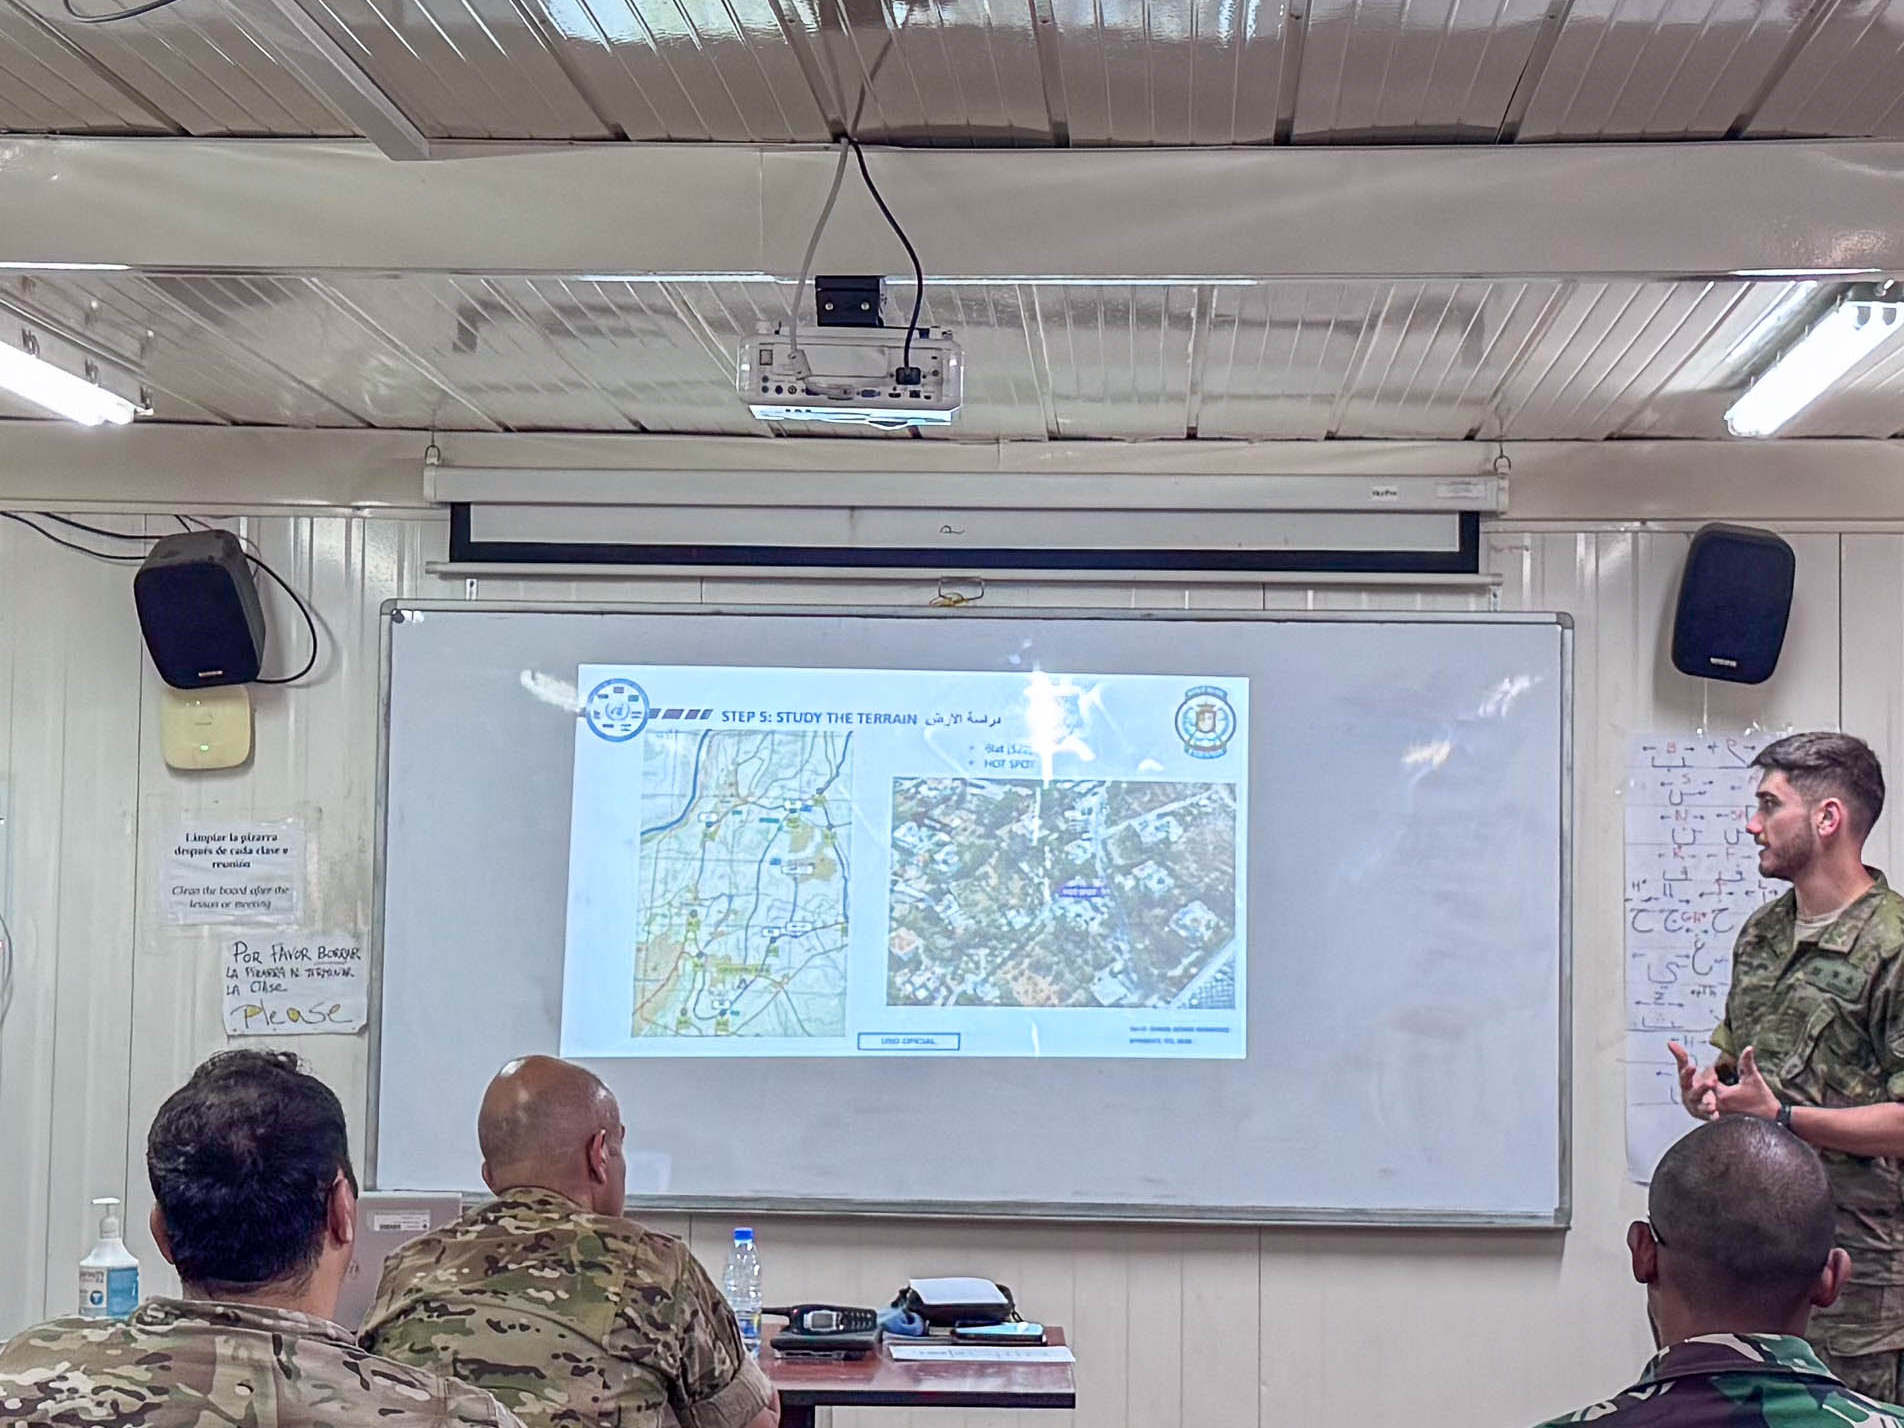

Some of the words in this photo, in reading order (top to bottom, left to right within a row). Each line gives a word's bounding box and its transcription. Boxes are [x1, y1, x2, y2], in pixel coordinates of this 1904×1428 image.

[721, 710, 755, 723] STEP
[759, 711, 773, 723] 5:
[776, 711, 822, 724] STUDY
[826, 712, 853, 724] THE
[857, 712, 918, 725] TERRAIN
[185, 832, 227, 844] Limpiar
[229, 832, 239, 843] la
[241, 832, 278, 844] pizarra
[215, 846, 228, 856] de
[230, 845, 254, 855] cada
[256, 845, 280, 855] clase
[171, 885, 201, 896] Clean
[202, 885, 217, 896] the
[219, 885, 248, 896] board
[249, 885, 273, 897] after
[274, 885, 290, 895] the
[189, 899, 219, 909] lesson
[220, 900, 232, 909] or
[234, 900, 272, 911] meeting
[232, 940, 263, 964] POR
[271, 942, 312, 963] FAVOR
[226, 966, 239, 979] LA
[226, 984, 240, 996] LA
[230, 998, 353, 1029] Please
